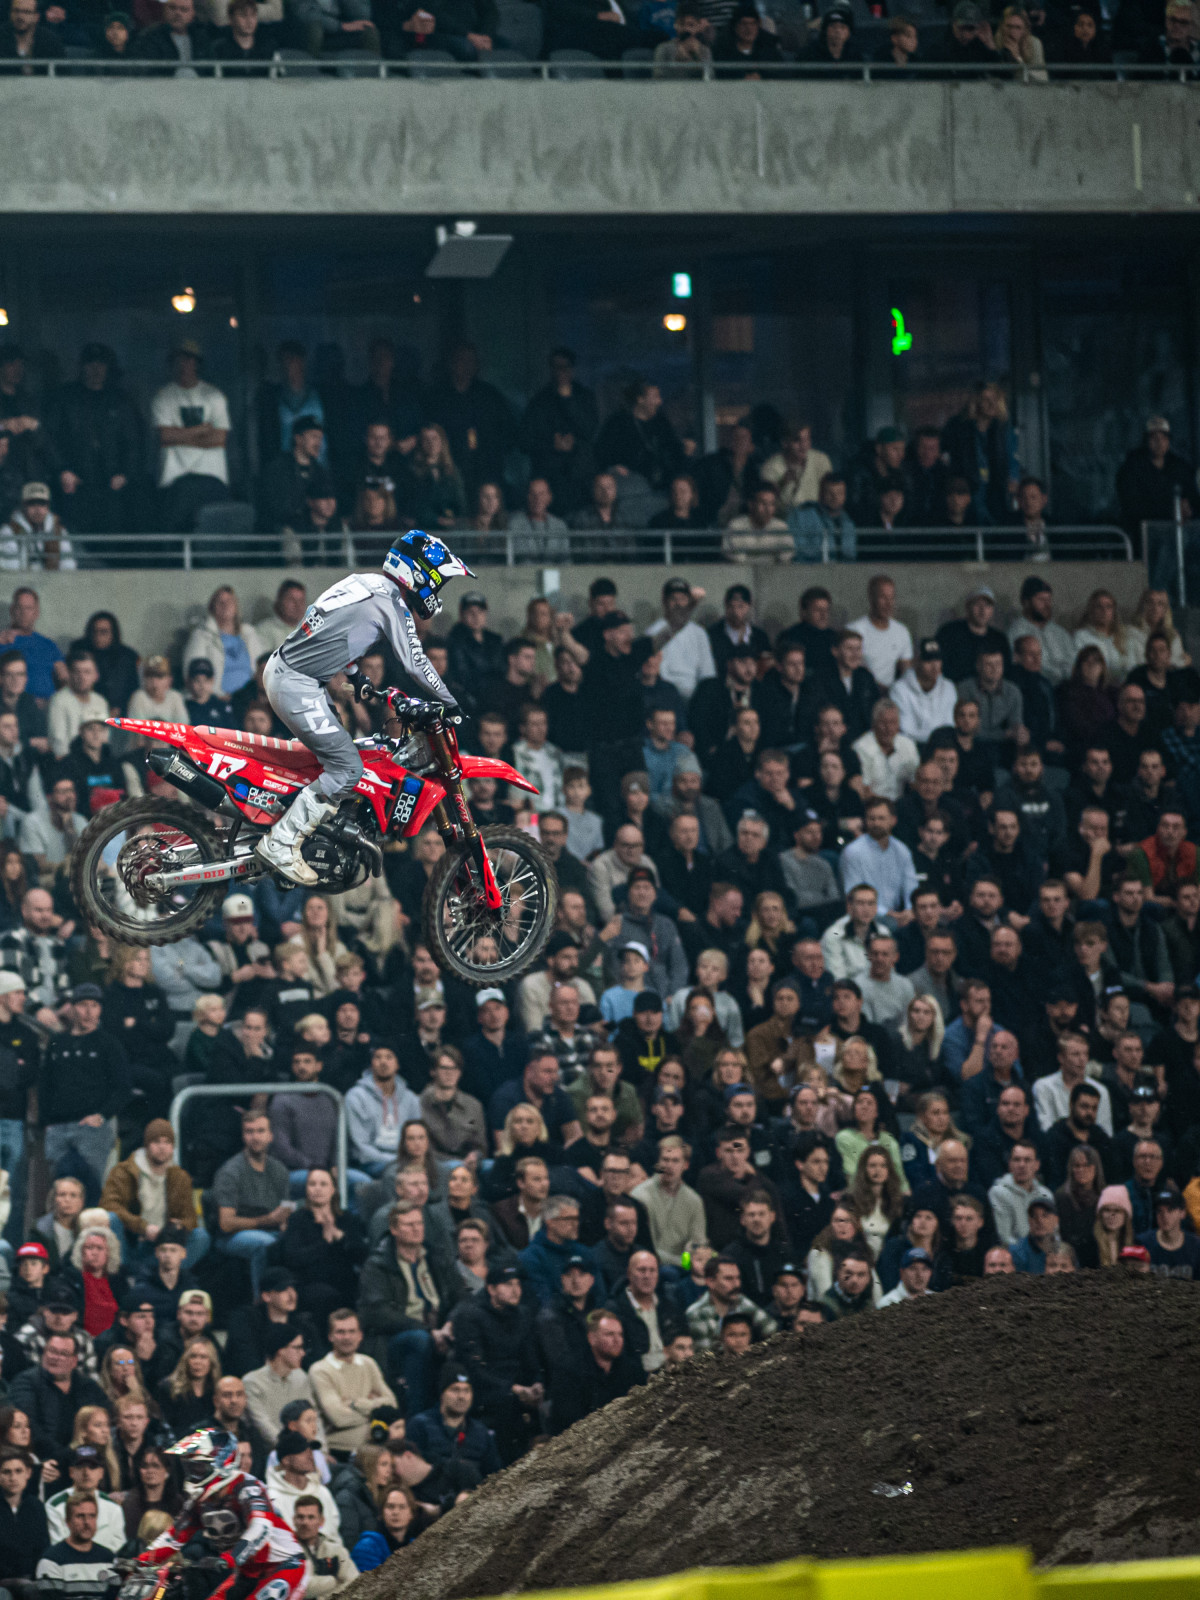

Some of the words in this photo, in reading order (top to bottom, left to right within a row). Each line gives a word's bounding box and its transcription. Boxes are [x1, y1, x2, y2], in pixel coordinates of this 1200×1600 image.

[224, 740, 254, 753] HONDA
[207, 752, 247, 780] 17
[393, 792, 409, 822] LOCK
